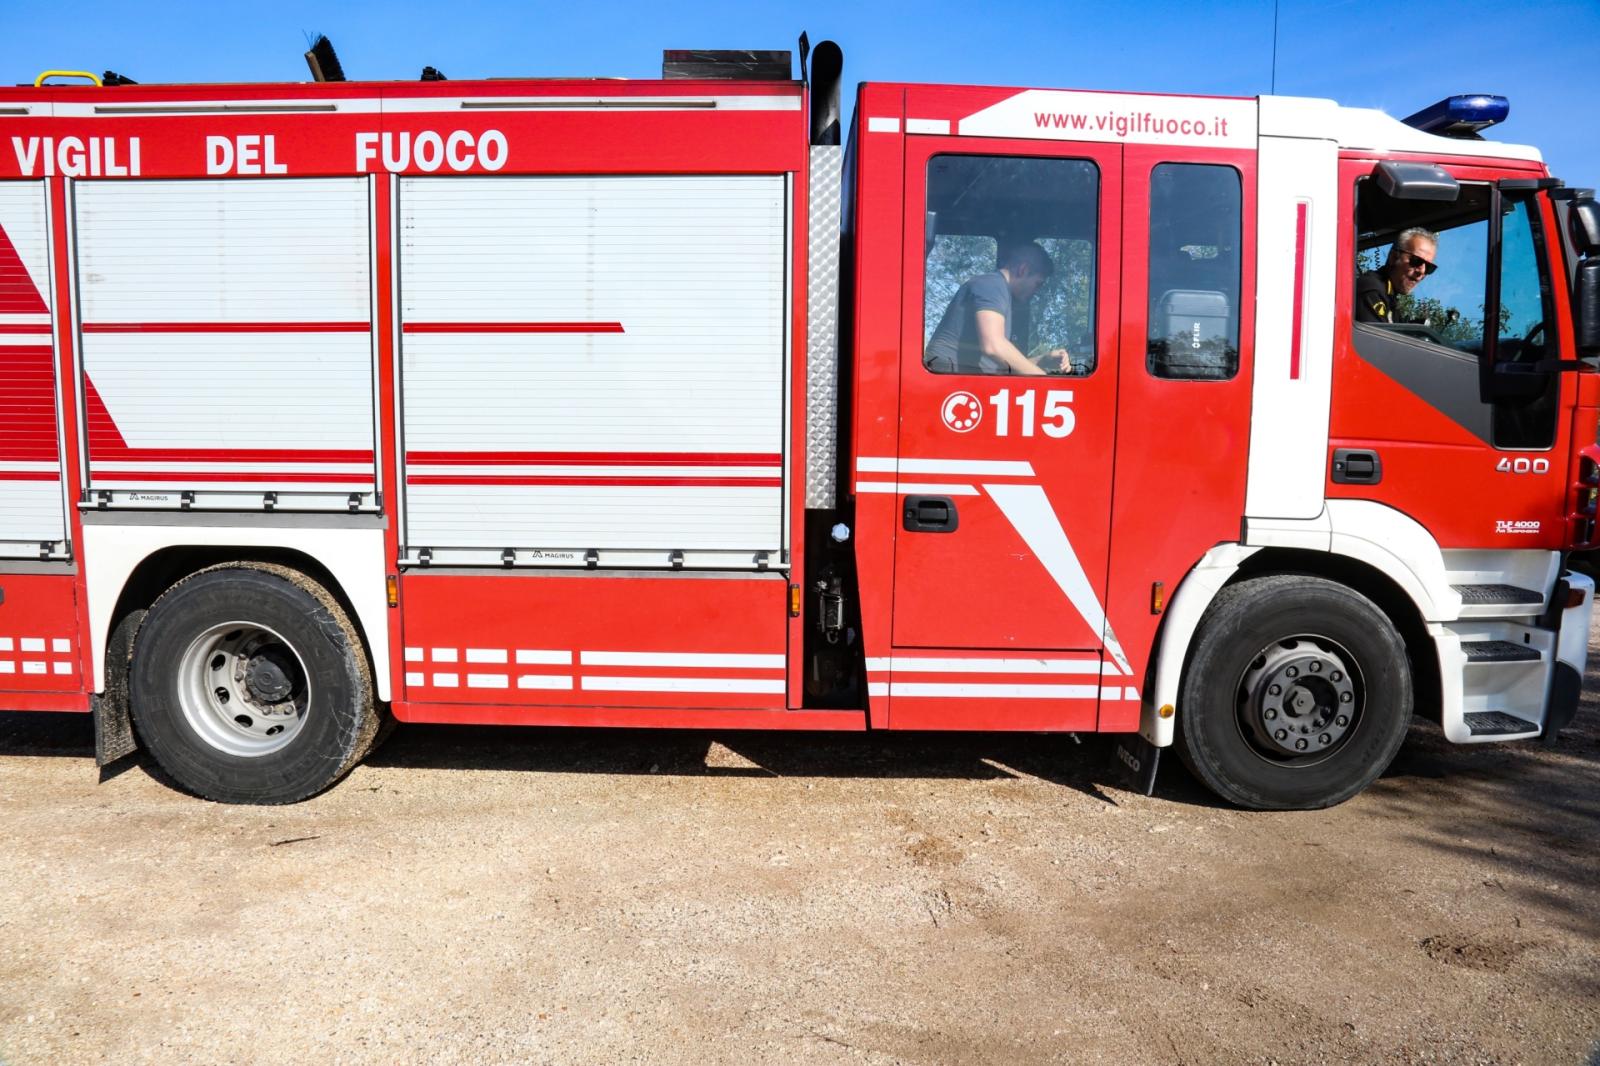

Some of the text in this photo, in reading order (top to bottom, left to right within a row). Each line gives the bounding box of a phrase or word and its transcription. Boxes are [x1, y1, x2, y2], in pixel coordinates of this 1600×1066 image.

[1034, 111, 1228, 137] www.vigilfuoco.it
[11, 129, 509, 176] VIGILI DEL FUOCO
[989, 388, 1076, 438] 115
[1496, 457, 1550, 474] 400
[1513, 520, 1540, 529] 4000
